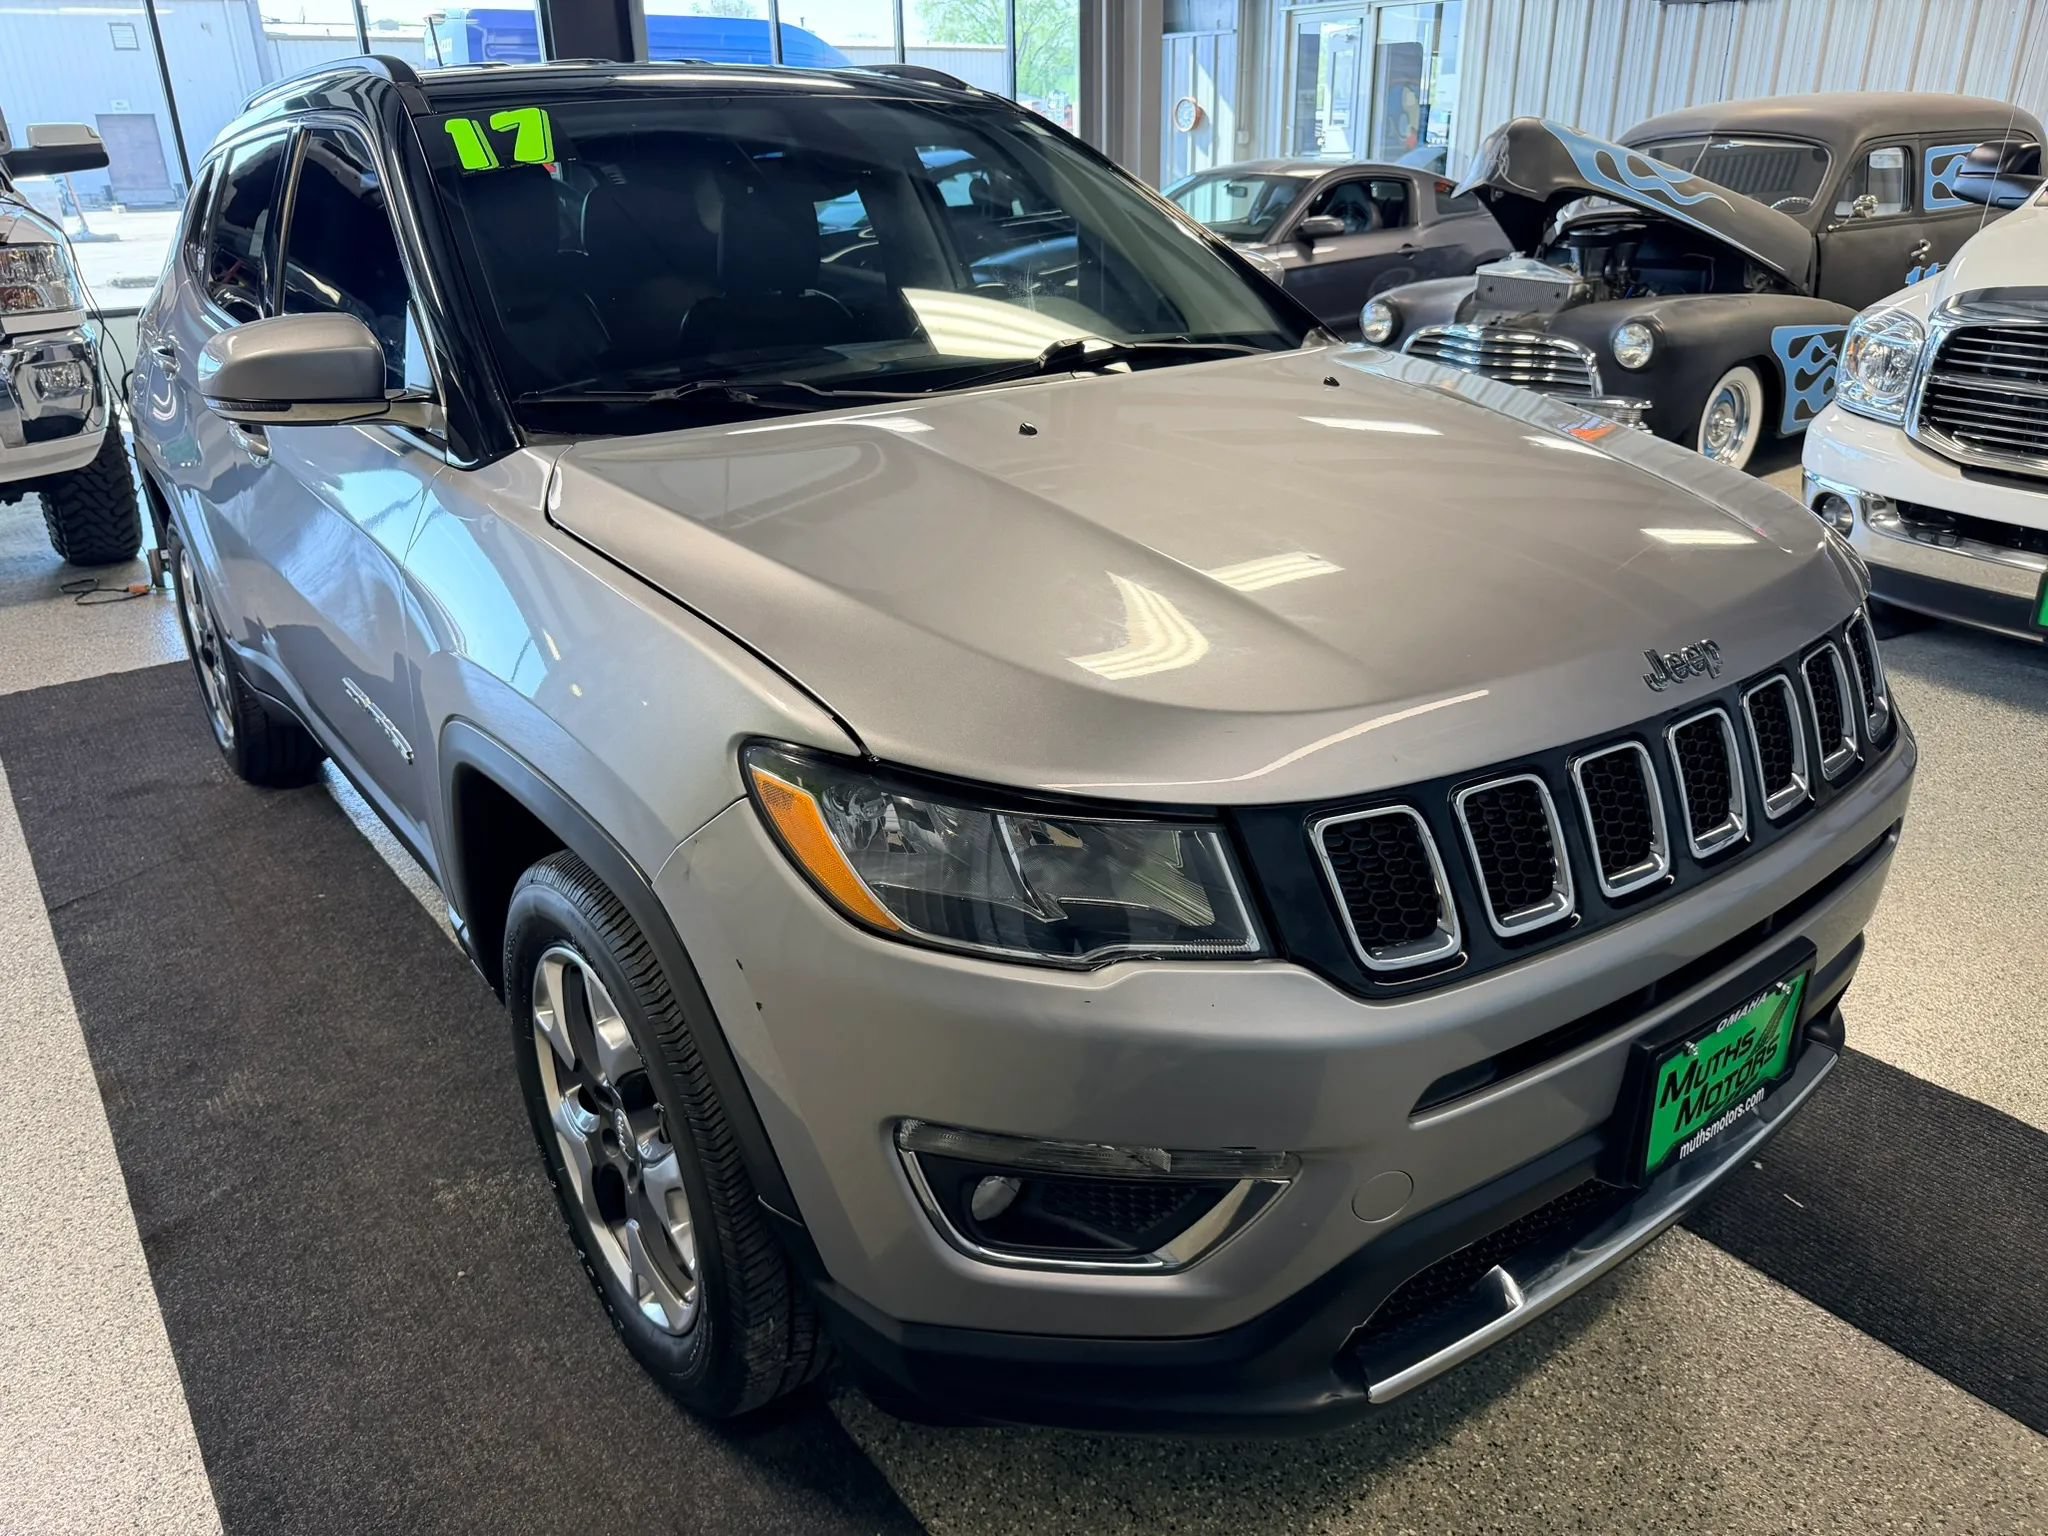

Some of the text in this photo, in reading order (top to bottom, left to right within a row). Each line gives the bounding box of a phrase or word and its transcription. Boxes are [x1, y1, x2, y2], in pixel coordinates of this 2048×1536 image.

[444, 107, 555, 171] 17
[1642, 640, 1721, 692] Jeep
[1716, 992, 1768, 1033] OMAHA
[1659, 1026, 1757, 1109] MUTHS
[1673, 1033, 1781, 1133] MOTORS
[1679, 1087, 1765, 1159] muthsmotors.com
